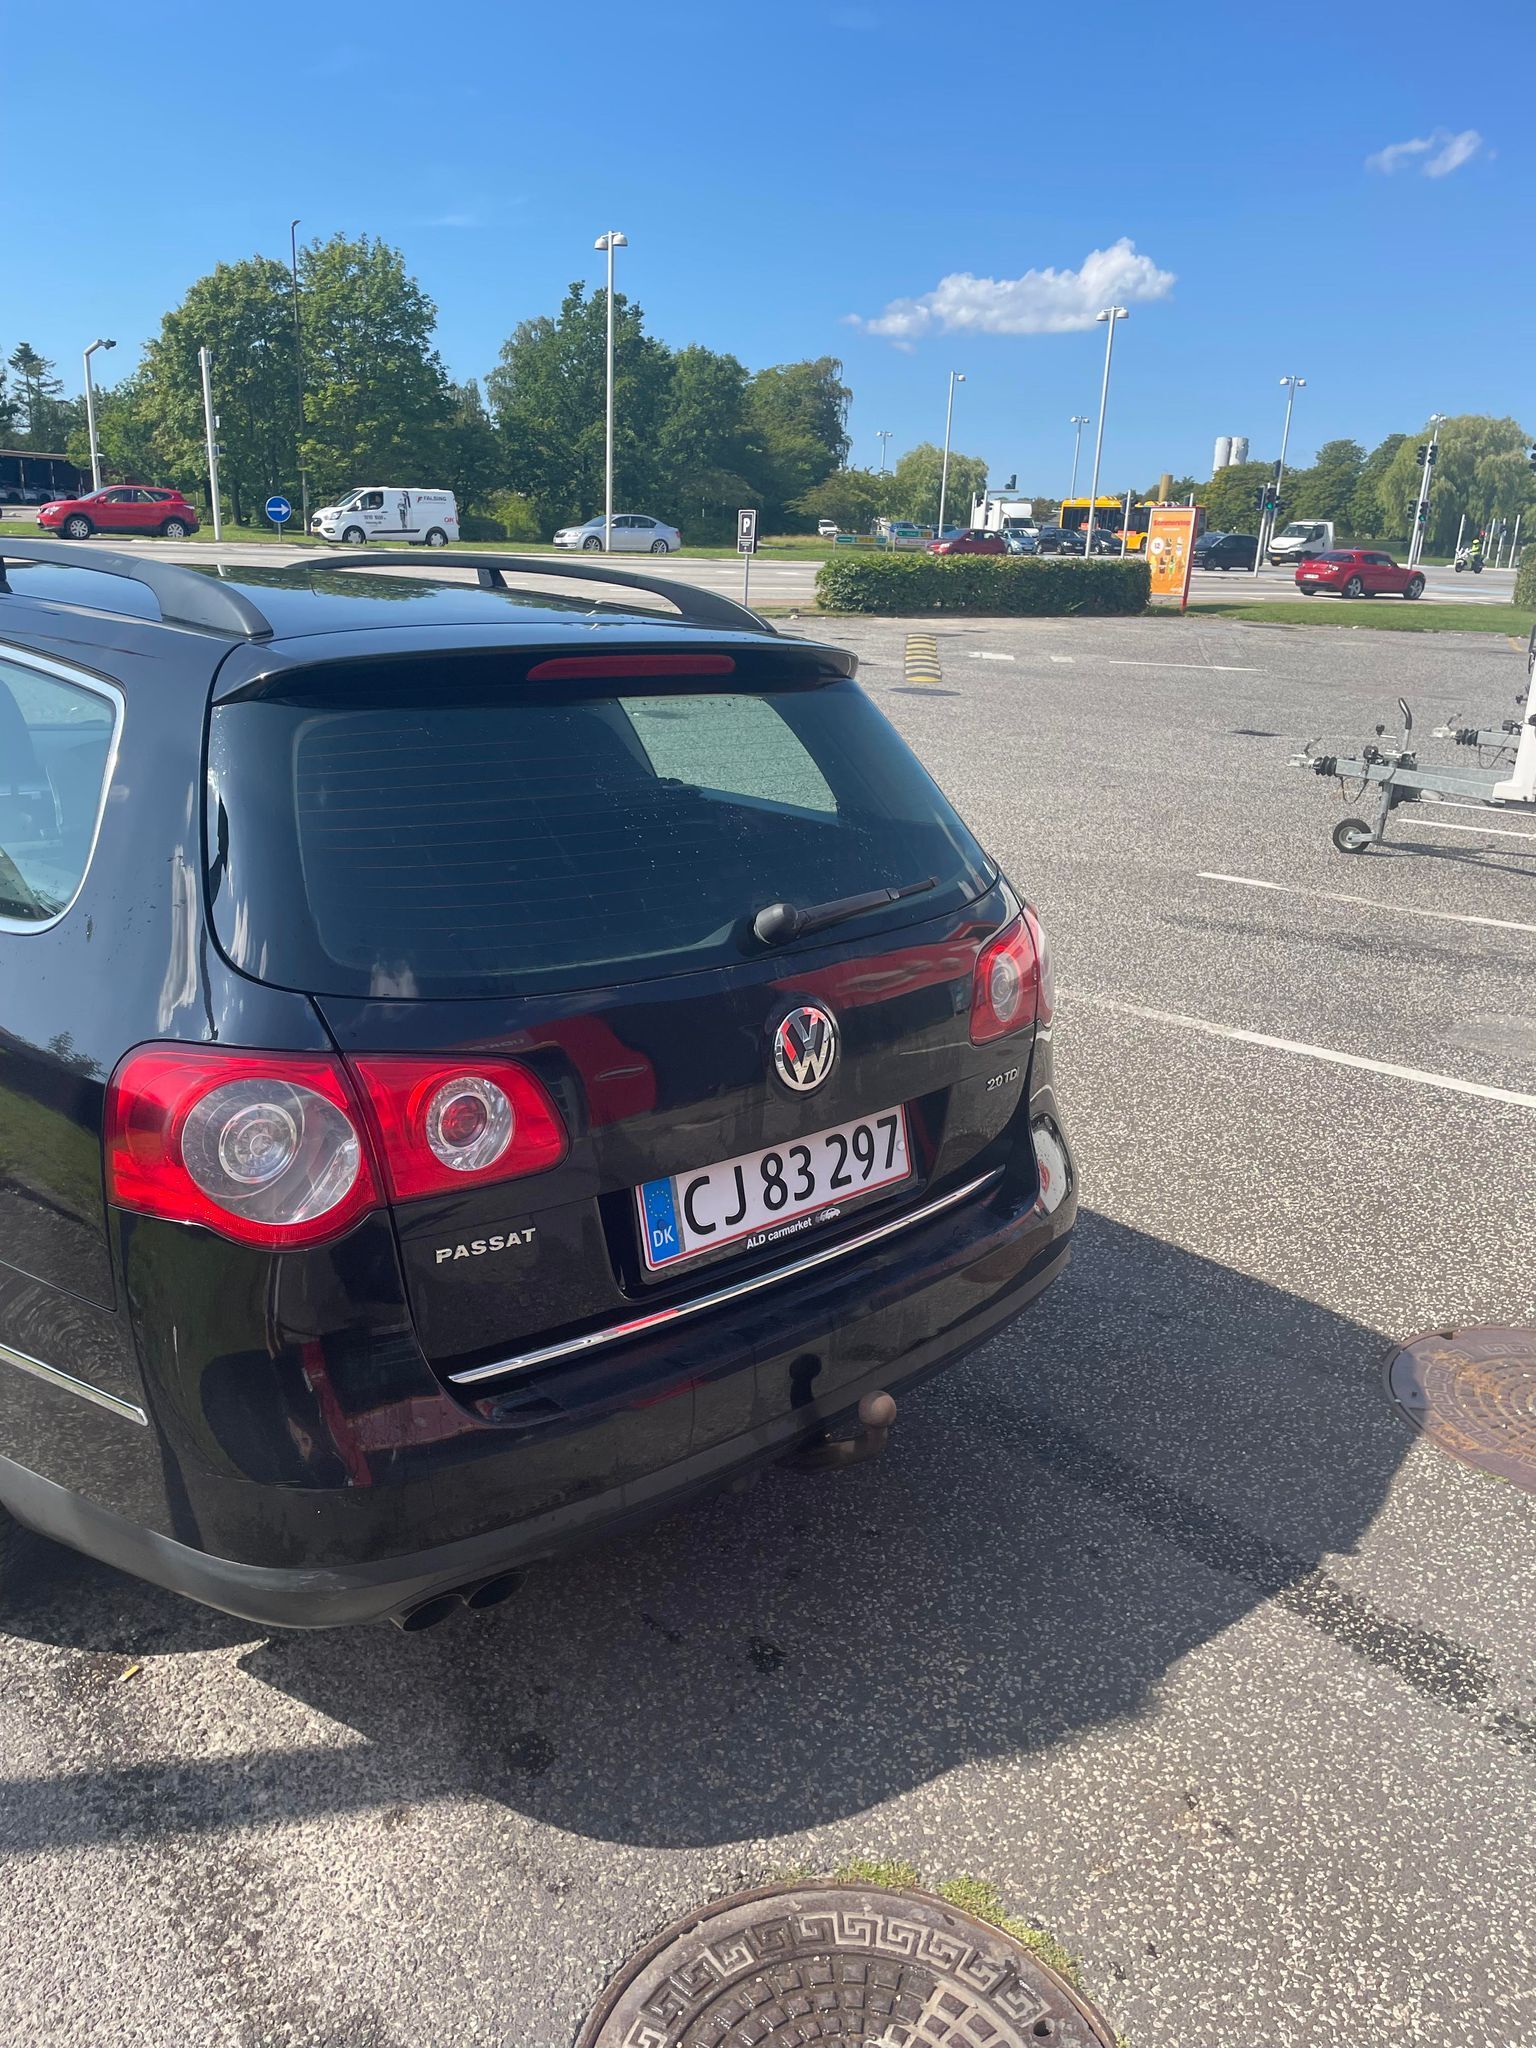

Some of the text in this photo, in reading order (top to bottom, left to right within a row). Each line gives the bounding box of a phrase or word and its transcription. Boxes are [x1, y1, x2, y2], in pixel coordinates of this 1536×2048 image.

[743, 517, 751, 533] P
[684, 1114, 897, 1235] CJ 83 297
[435, 1227, 536, 1264] PASSAT
[653, 1225, 674, 1247] DK
[746, 1217, 812, 1249] ALD carmarket
